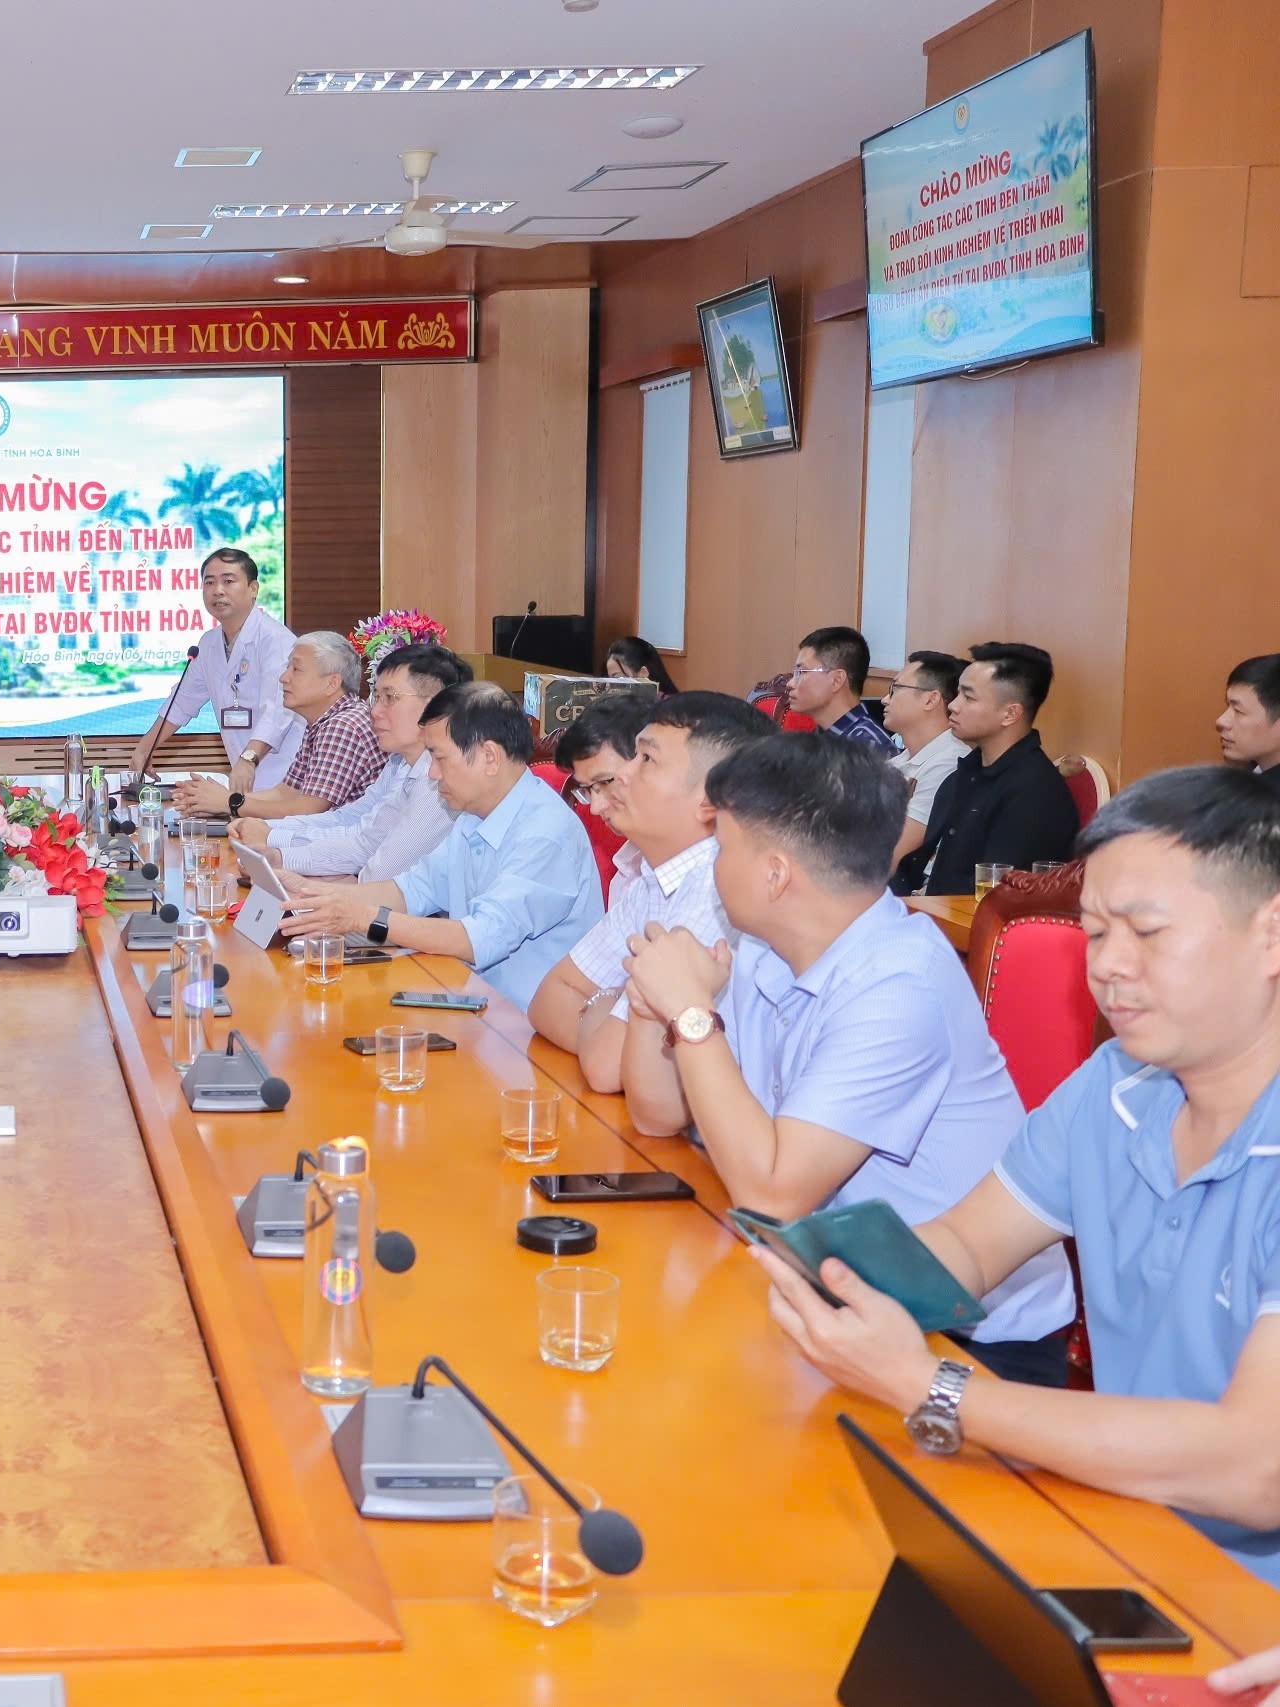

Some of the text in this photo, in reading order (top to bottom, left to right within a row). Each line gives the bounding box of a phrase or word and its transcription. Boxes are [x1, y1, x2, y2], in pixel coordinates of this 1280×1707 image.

[920, 151, 1011, 207] CHÀO MỪNG
[896, 257, 915, 278] TRAO
[934, 244, 954, 265] KINH
[1040, 204, 1064, 230] KHAI
[83, 324, 177, 356] VINH
[188, 310, 296, 353] MUÔN
[307, 310, 388, 351] NĂM
[19, 523, 70, 552] TỈNH
[78, 520, 122, 551] ĐẾN
[130, 524, 193, 550] THĂM
[63, 562, 90, 592] VỀ
[98, 559, 162, 592] TRIỂN
[171, 568, 202, 591] KH
[34, 611, 93, 634] BVĐK
[100, 604, 150, 632] TỈNH
[159, 603, 204, 632] HÒA
